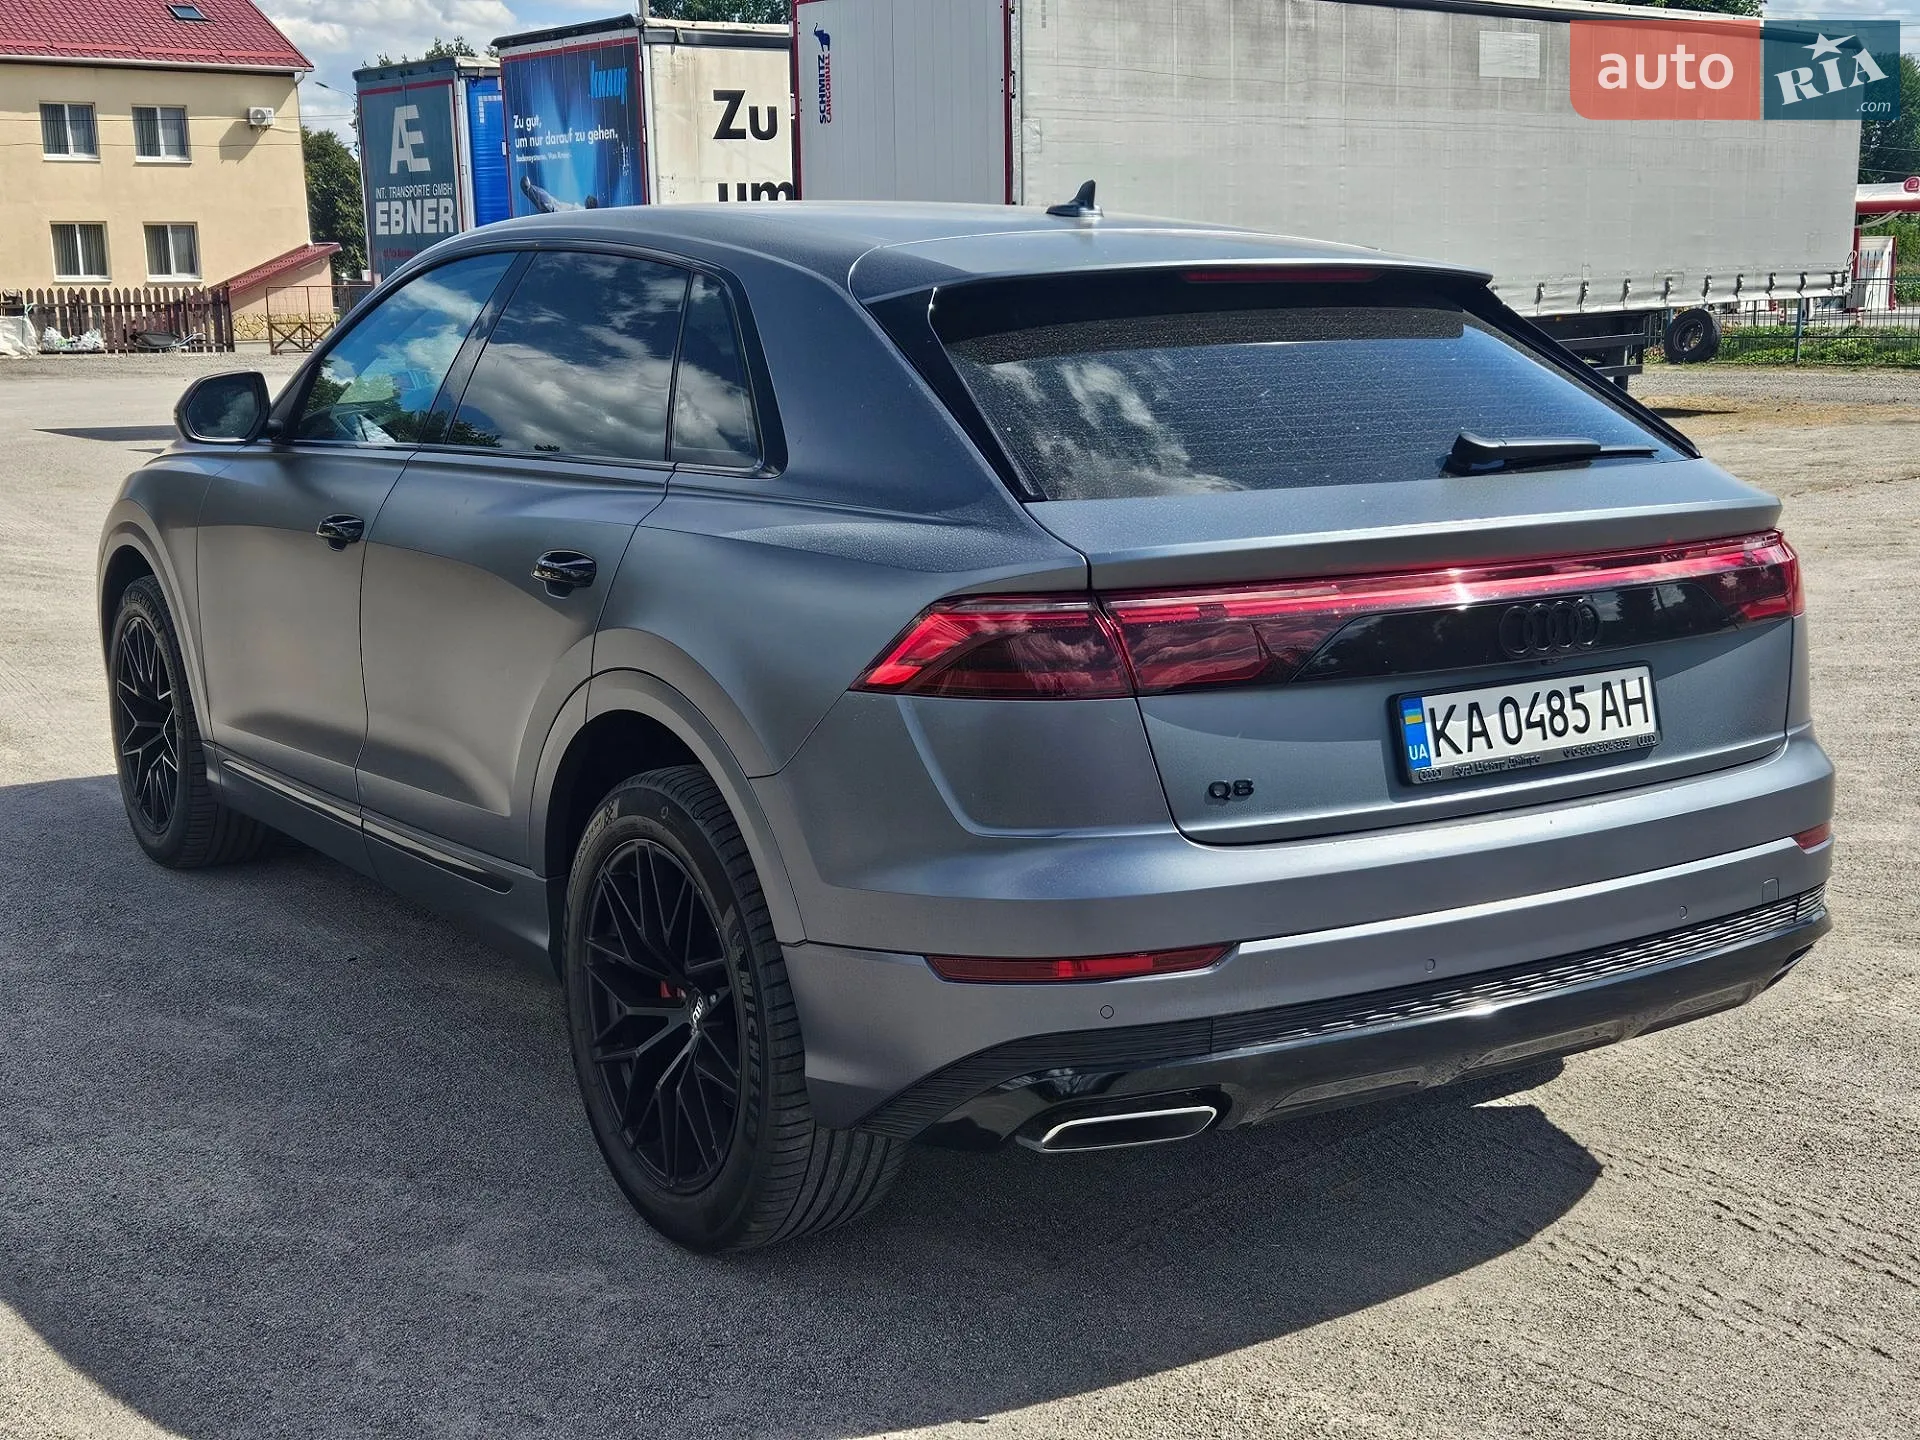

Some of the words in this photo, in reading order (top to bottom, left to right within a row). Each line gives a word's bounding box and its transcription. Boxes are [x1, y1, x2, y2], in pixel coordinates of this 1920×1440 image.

[818, 54, 827, 124] SCHMITZ
[513, 115, 524, 129] Zu
[526, 115, 542, 131] gut,
[713, 90, 778, 140] Zu
[515, 136, 528, 148] um
[530, 136, 542, 147] nur
[545, 128, 572, 145] darauf
[575, 132, 586, 141] zu
[588, 125, 618, 145] gehen.
[389, 184, 430, 198] TRANSPORTE
[432, 183, 453, 196] GMBH
[376, 198, 454, 235] EBNER
[1500, 685, 1590, 745] 0485
[1408, 745, 1428, 760] UA
[1208, 780, 1254, 800] Q8
